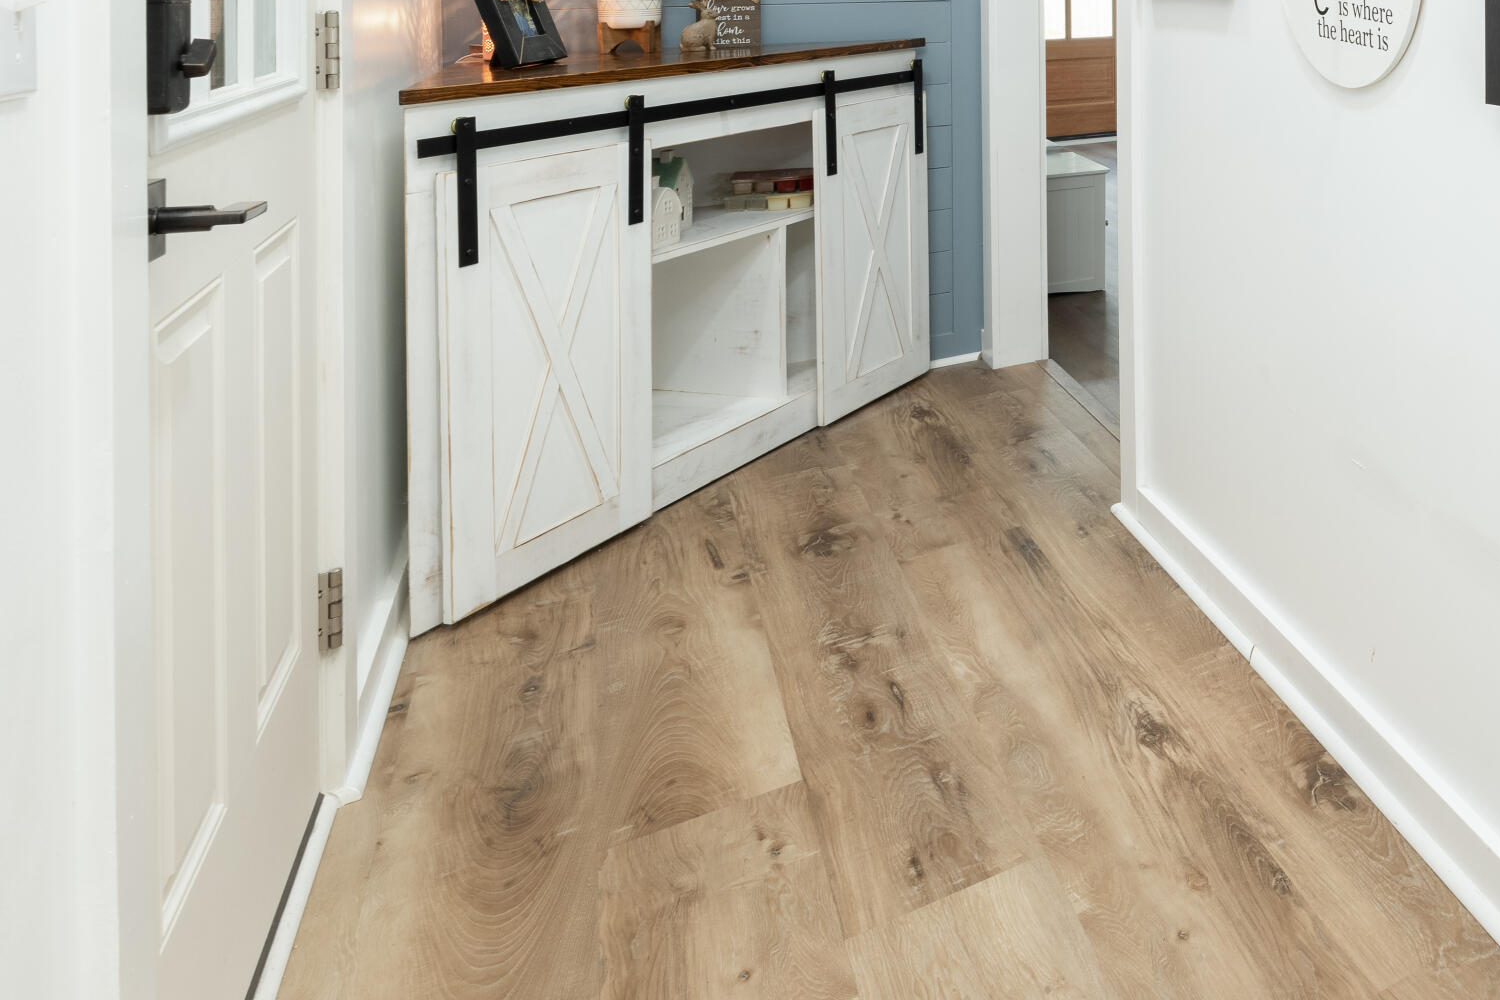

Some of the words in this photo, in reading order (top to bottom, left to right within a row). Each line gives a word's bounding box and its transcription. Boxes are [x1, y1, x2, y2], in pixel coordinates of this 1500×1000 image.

[731, 5, 756, 13] grows
[717, 21, 744, 37] home
[1317, 16, 1337, 41] the
[1339, 20, 1374, 49] heart
[1377, 27, 1389, 51] is
